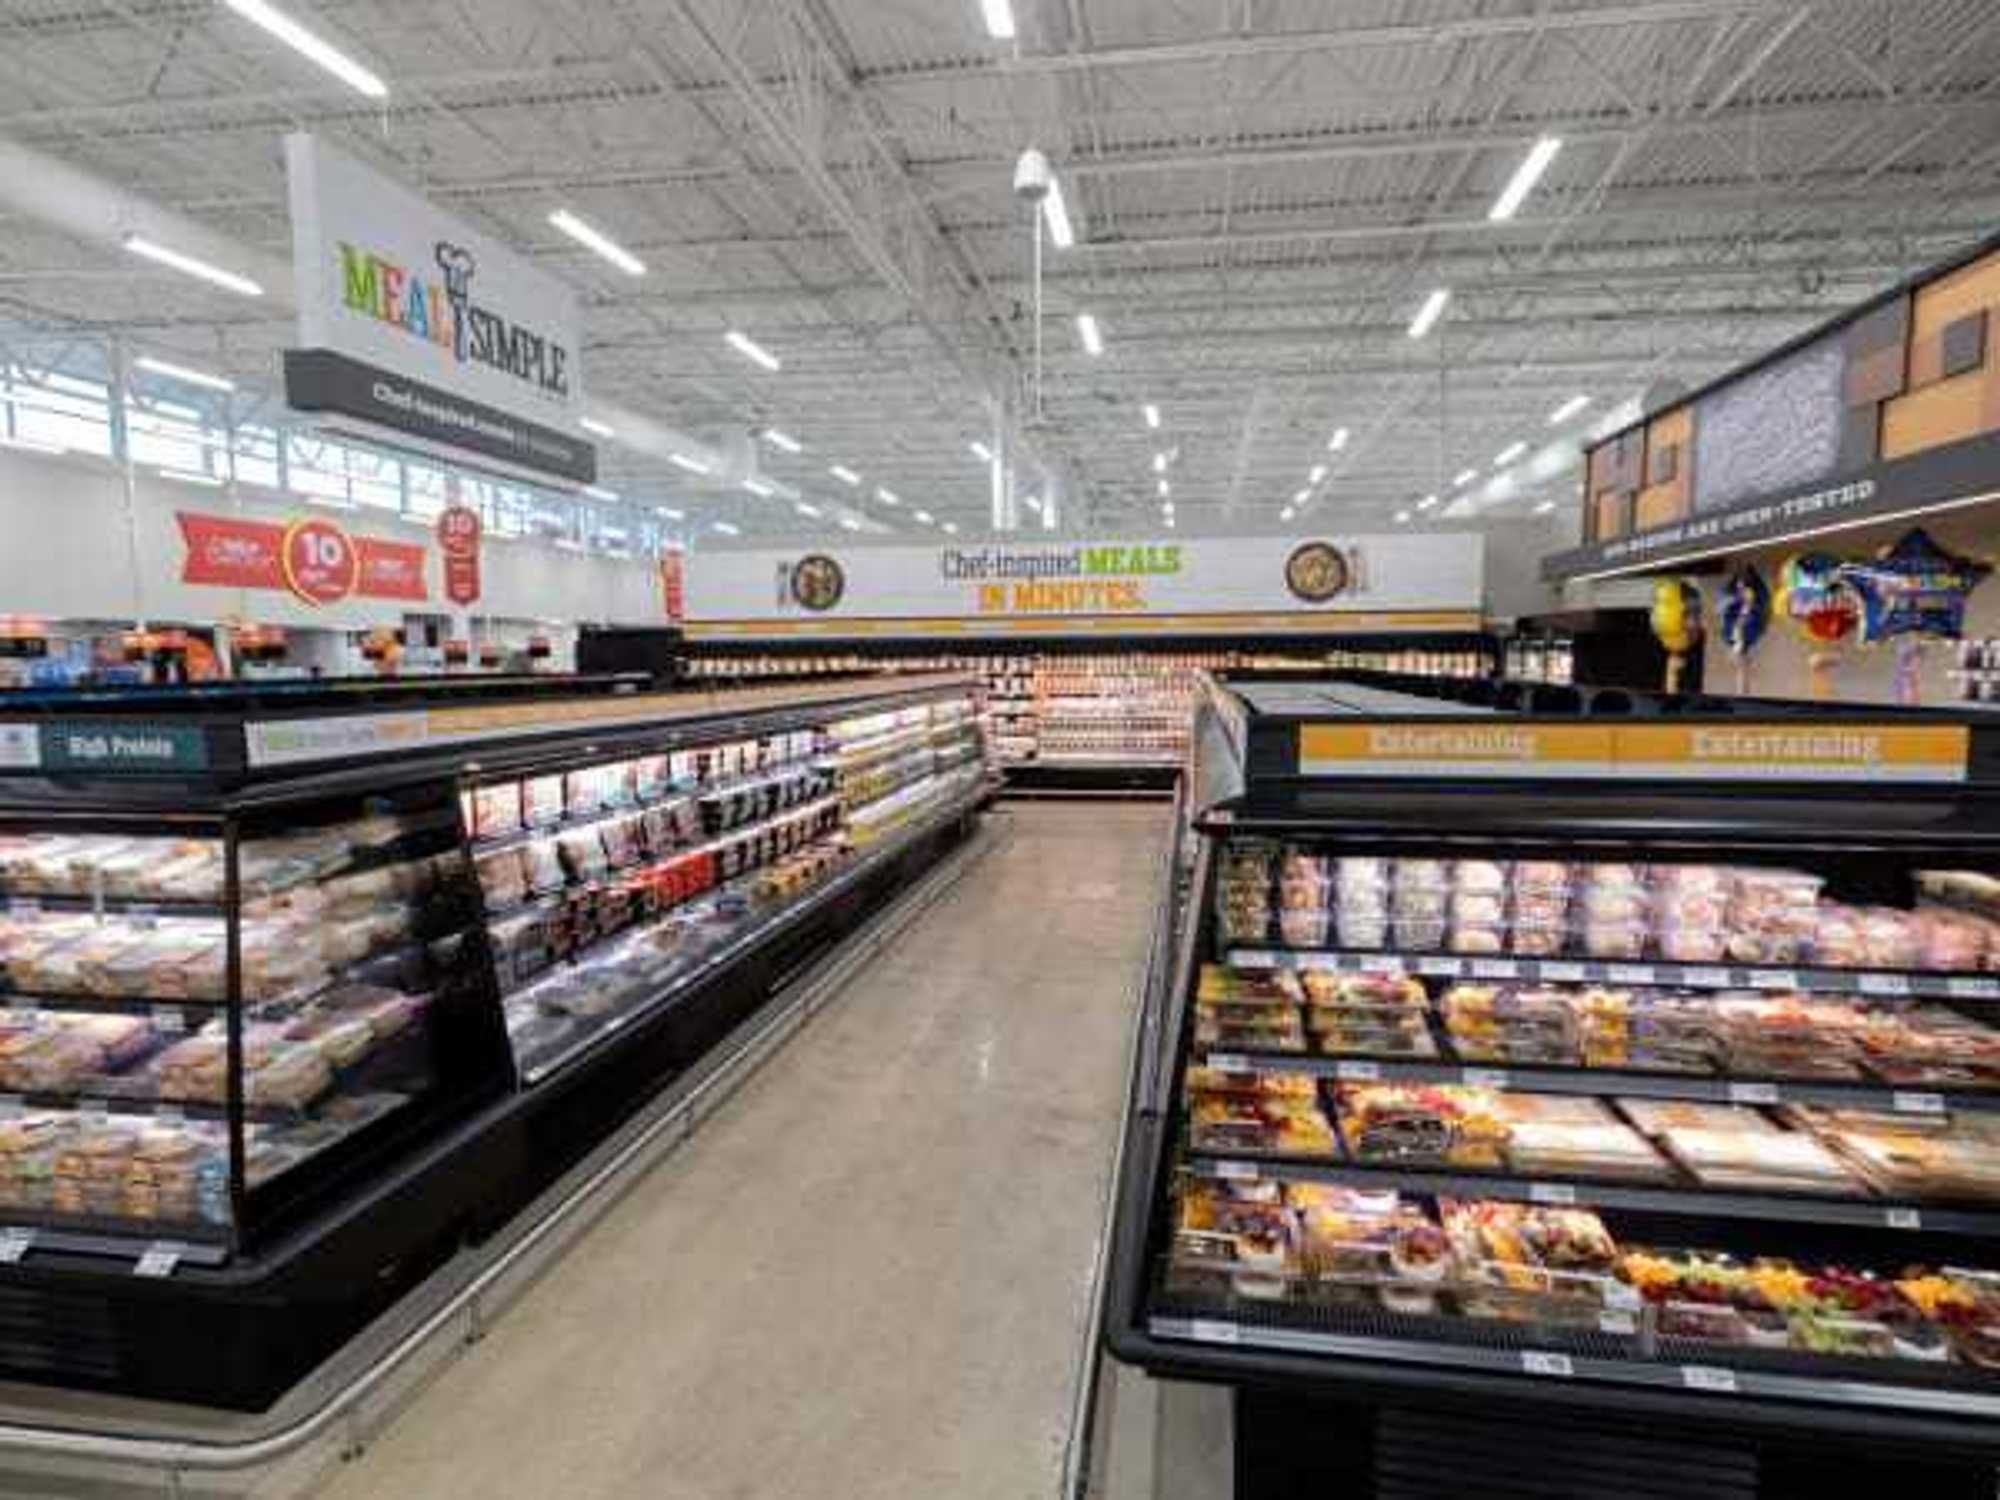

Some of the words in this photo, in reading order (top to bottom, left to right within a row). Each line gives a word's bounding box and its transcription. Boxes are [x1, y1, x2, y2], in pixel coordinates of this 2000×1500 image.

[337, 241, 454, 348] MEAL
[468, 306, 567, 396] SIMPLE
[302, 532, 343, 566] 10
[1083, 546, 1181, 574] MEALS
[1692, 728, 1880, 762] Entertaining
